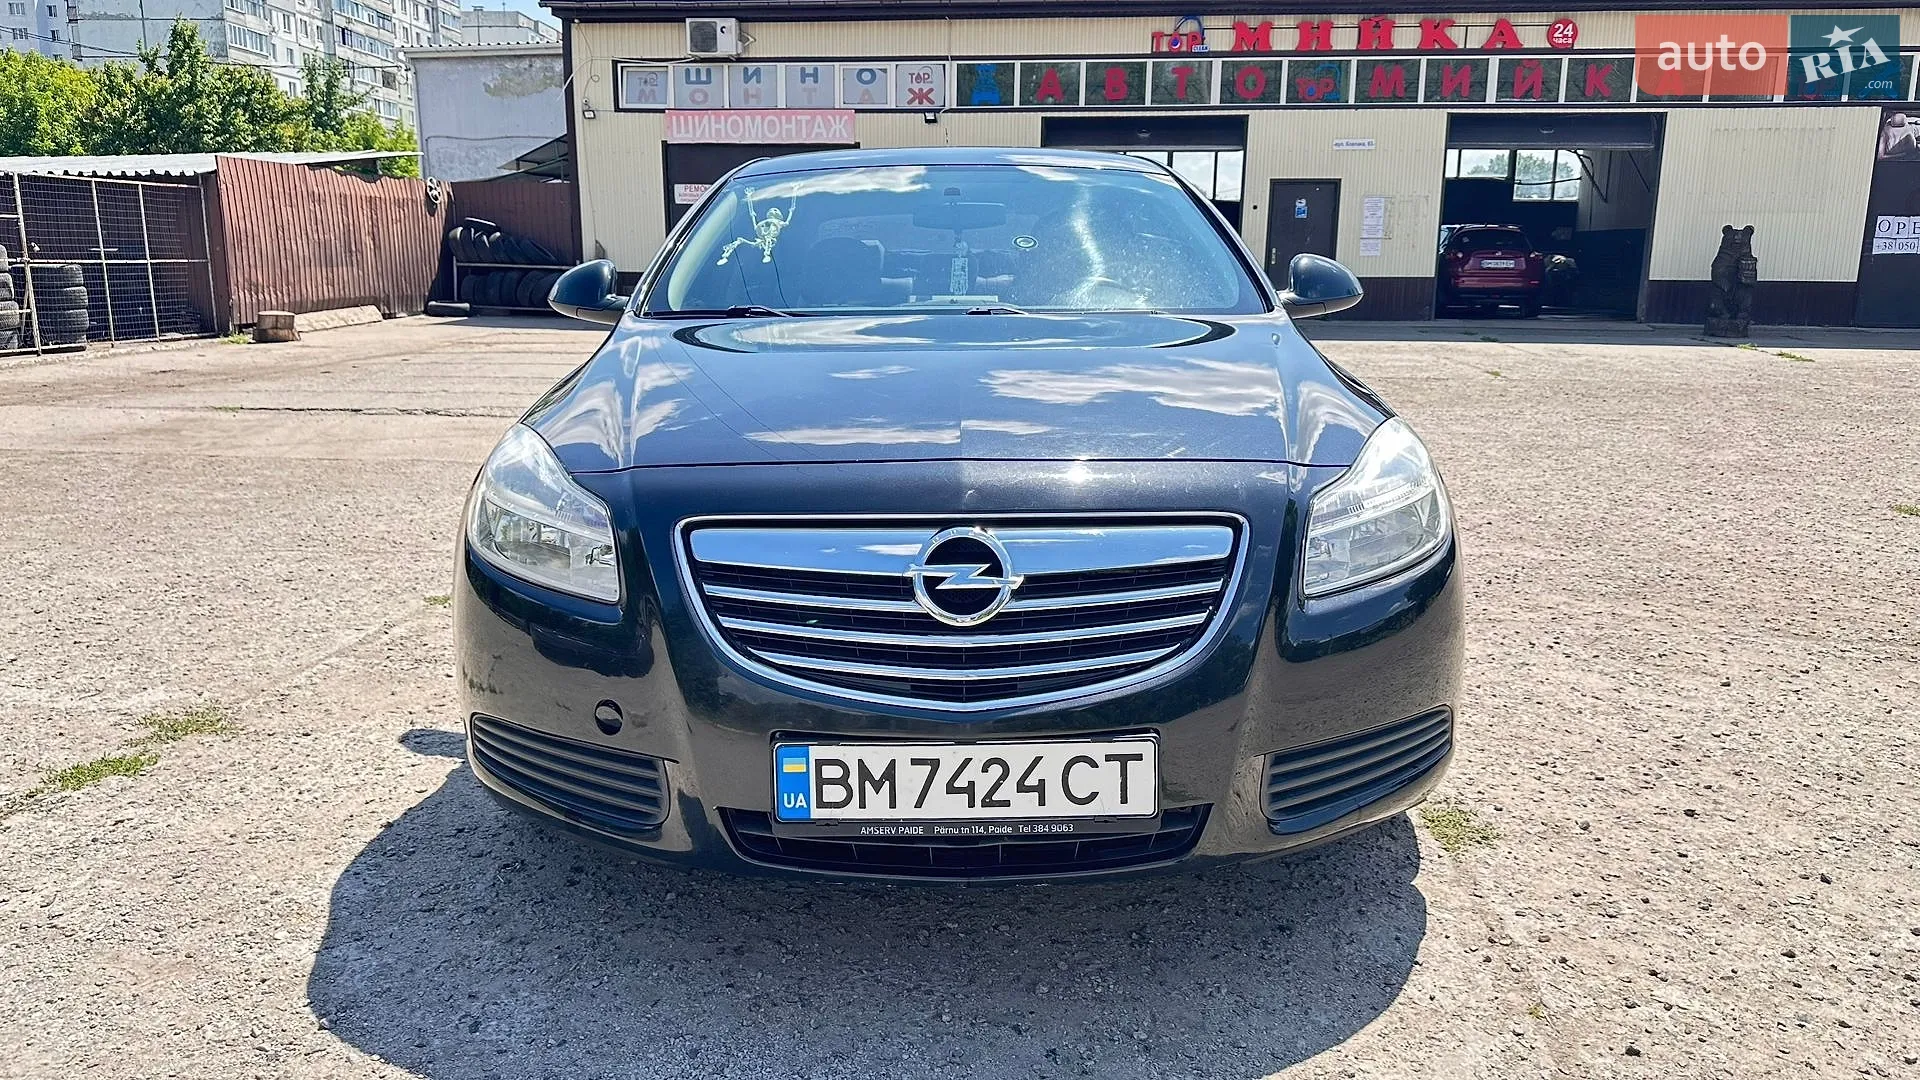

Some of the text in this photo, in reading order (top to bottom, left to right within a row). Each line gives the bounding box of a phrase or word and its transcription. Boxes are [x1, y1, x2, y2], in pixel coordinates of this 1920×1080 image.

[1553, 23, 1574, 37] 24
[672, 114, 849, 139] ШИНОМОНТАЖ
[814, 753, 1144, 809] BM 7424 CT
[783, 793, 808, 809] UA
[860, 826, 897, 835] AMSERV
[899, 826, 924, 835] PAIDE
[961, 825, 970, 834] tn
[989, 825, 1013, 834] Paide
[1018, 824, 1031, 833] Tel
[1032, 824, 1049, 833] 384
[1051, 824, 1074, 833] 9063
